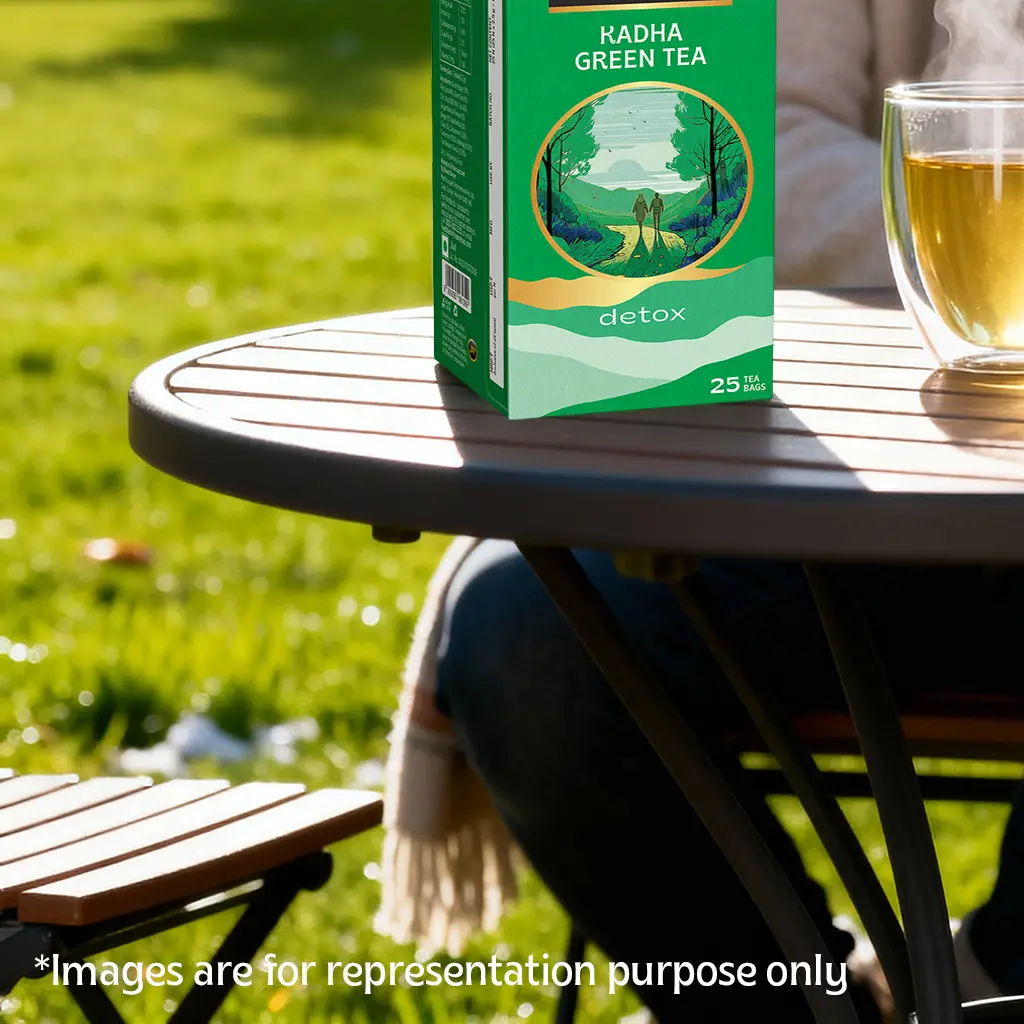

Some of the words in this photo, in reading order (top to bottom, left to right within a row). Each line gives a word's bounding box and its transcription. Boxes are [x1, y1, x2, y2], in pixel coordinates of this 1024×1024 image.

[600, 23, 683, 45] KADHA
[575, 49, 654, 71] GREEN
[663, 47, 707, 67] TEA
[599, 306, 686, 326] detox
[710, 376, 740, 394] 25
[743, 375, 760, 383] TEA
[743, 383, 767, 392] BAGS
